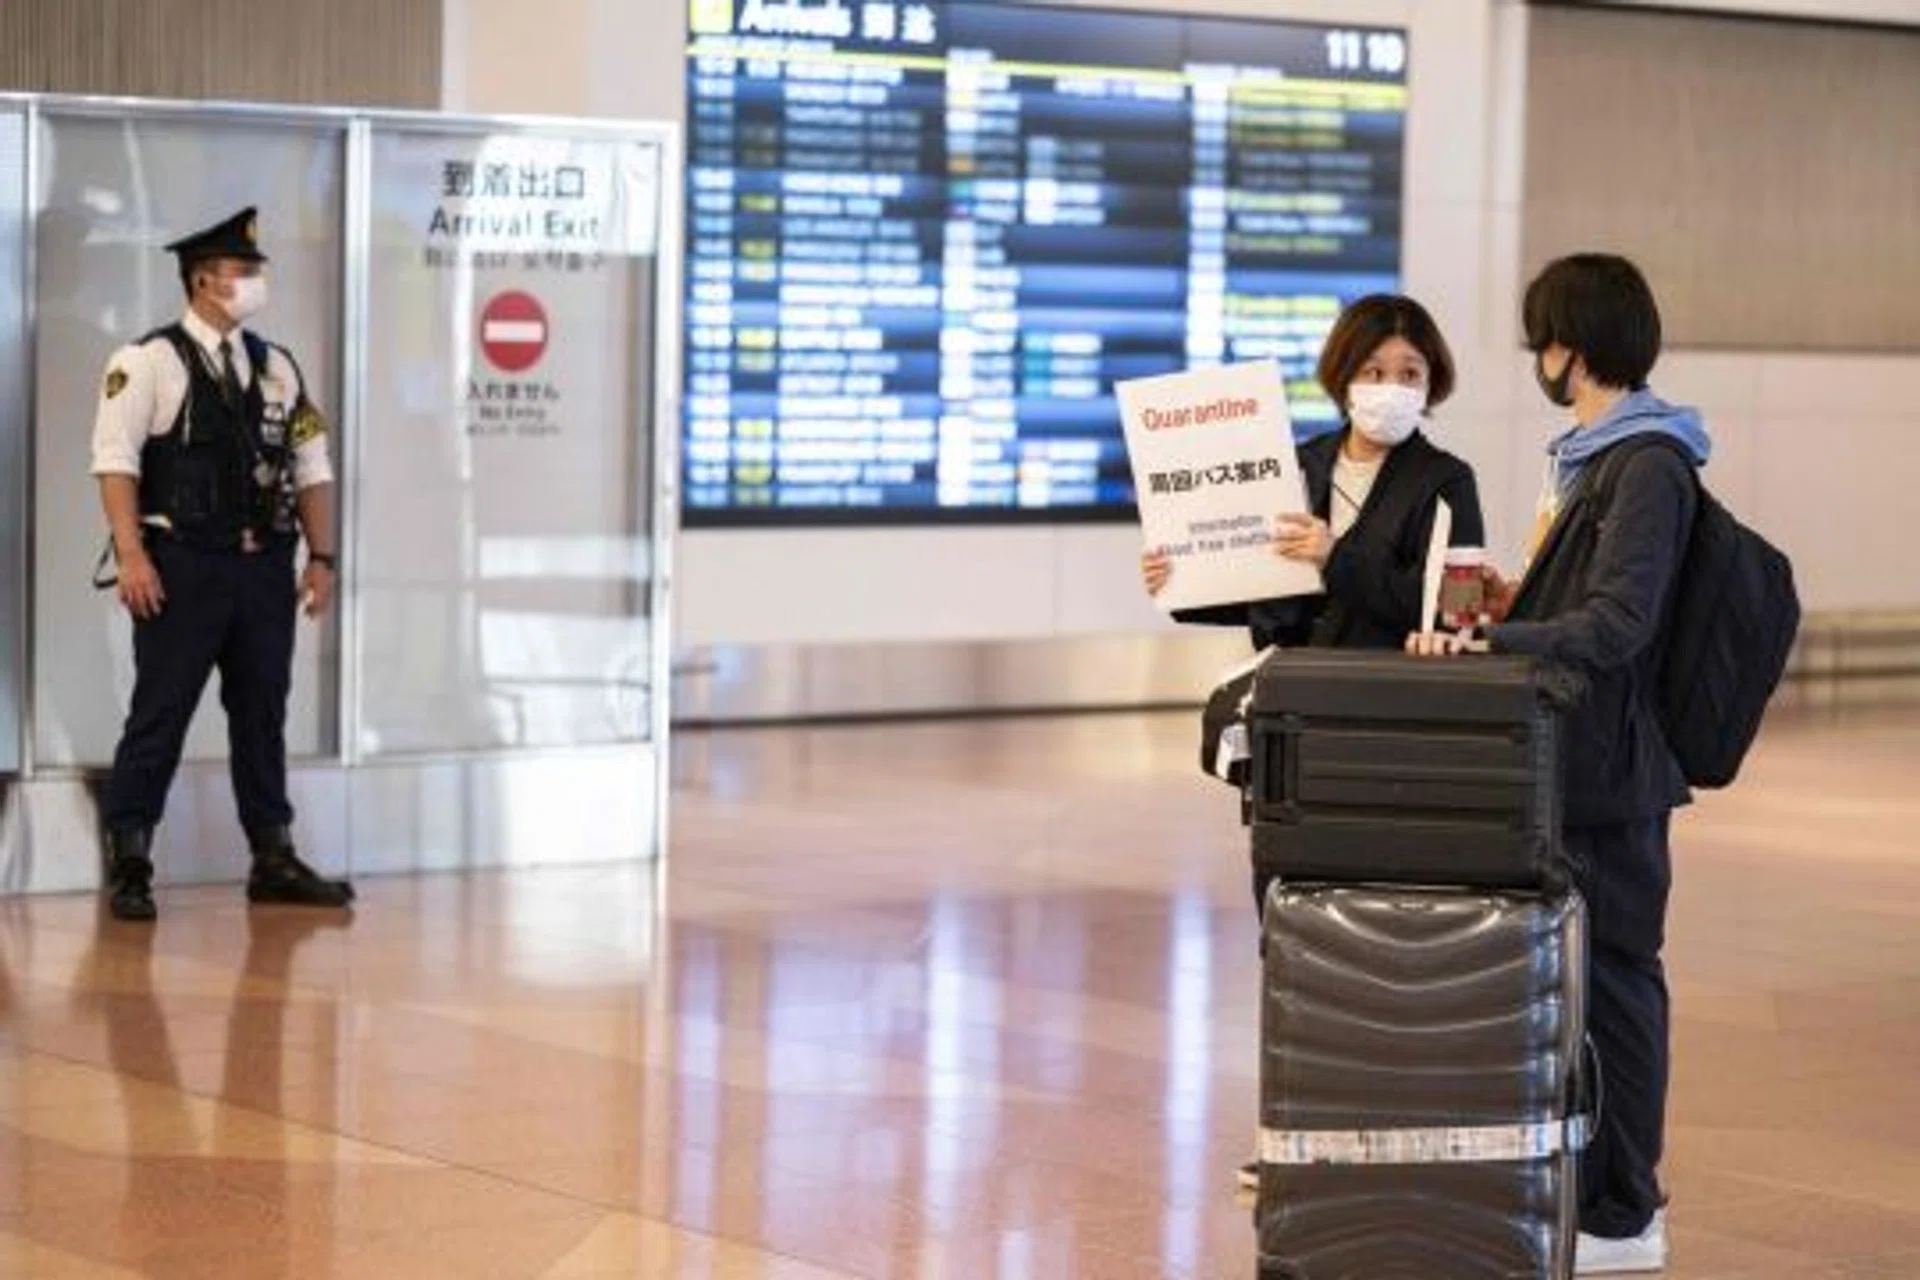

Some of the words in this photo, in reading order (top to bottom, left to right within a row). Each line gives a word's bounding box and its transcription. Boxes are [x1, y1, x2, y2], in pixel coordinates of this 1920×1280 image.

[429, 206, 533, 236] Arrival
[544, 211, 600, 240] Exit
[1141, 398, 1259, 432] Quarantine
